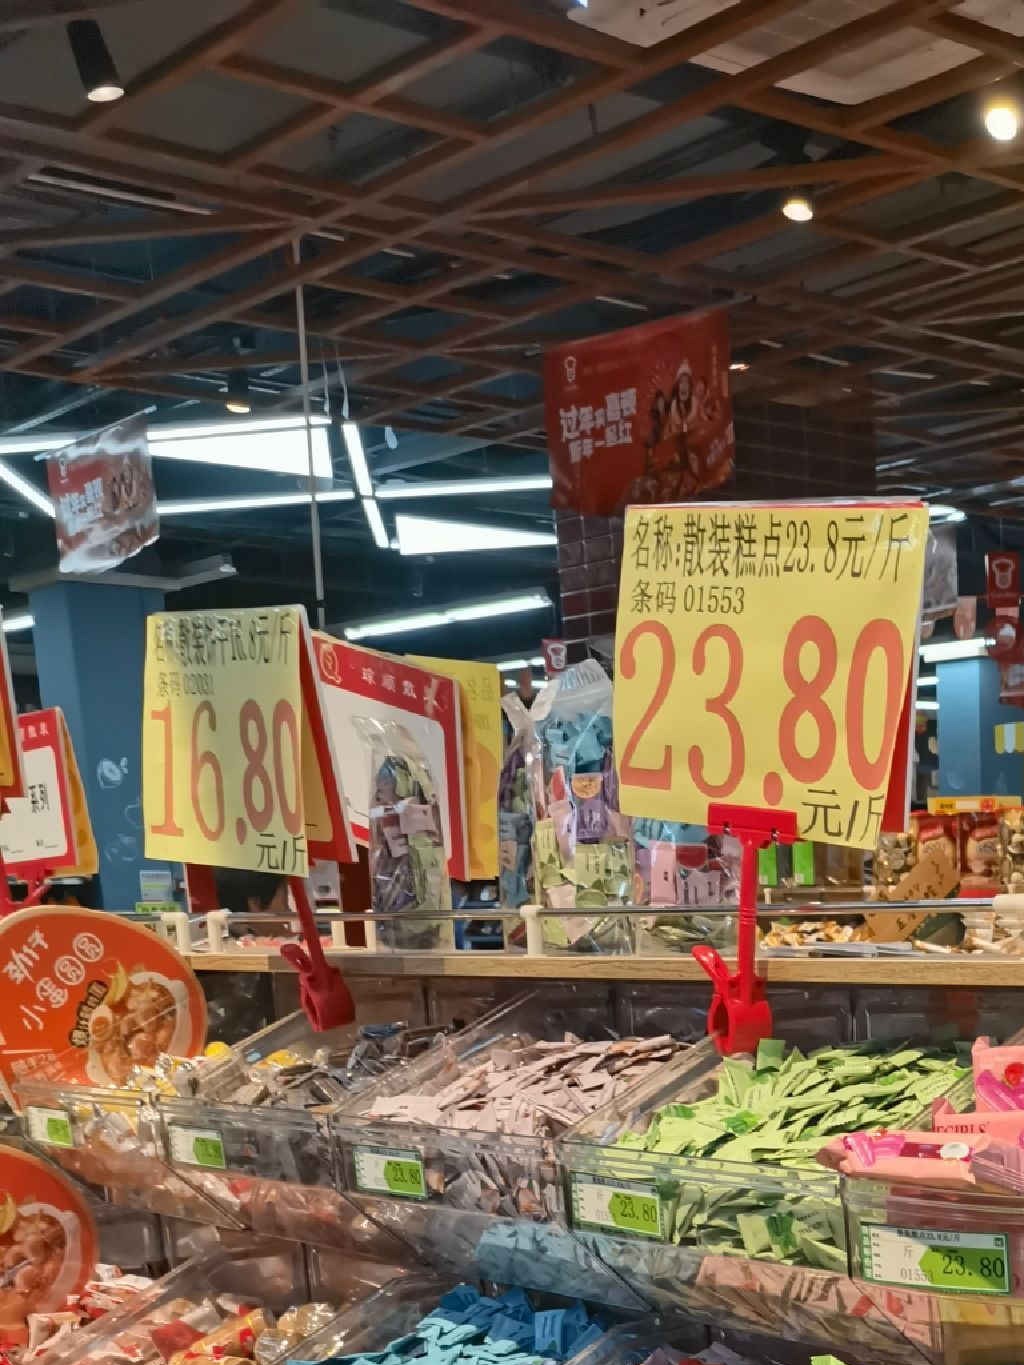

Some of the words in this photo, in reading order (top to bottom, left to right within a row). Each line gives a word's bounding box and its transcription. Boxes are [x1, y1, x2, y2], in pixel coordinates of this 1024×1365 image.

[630, 579, 677, 615] 条码
[683, 584, 746, 614] 01553
[619, 613, 905, 807] 23.80
[150, 698, 301, 846] 16.80
[618, 1199, 658, 1224] 23.80
[941, 1253, 1006, 1279] 23.80
